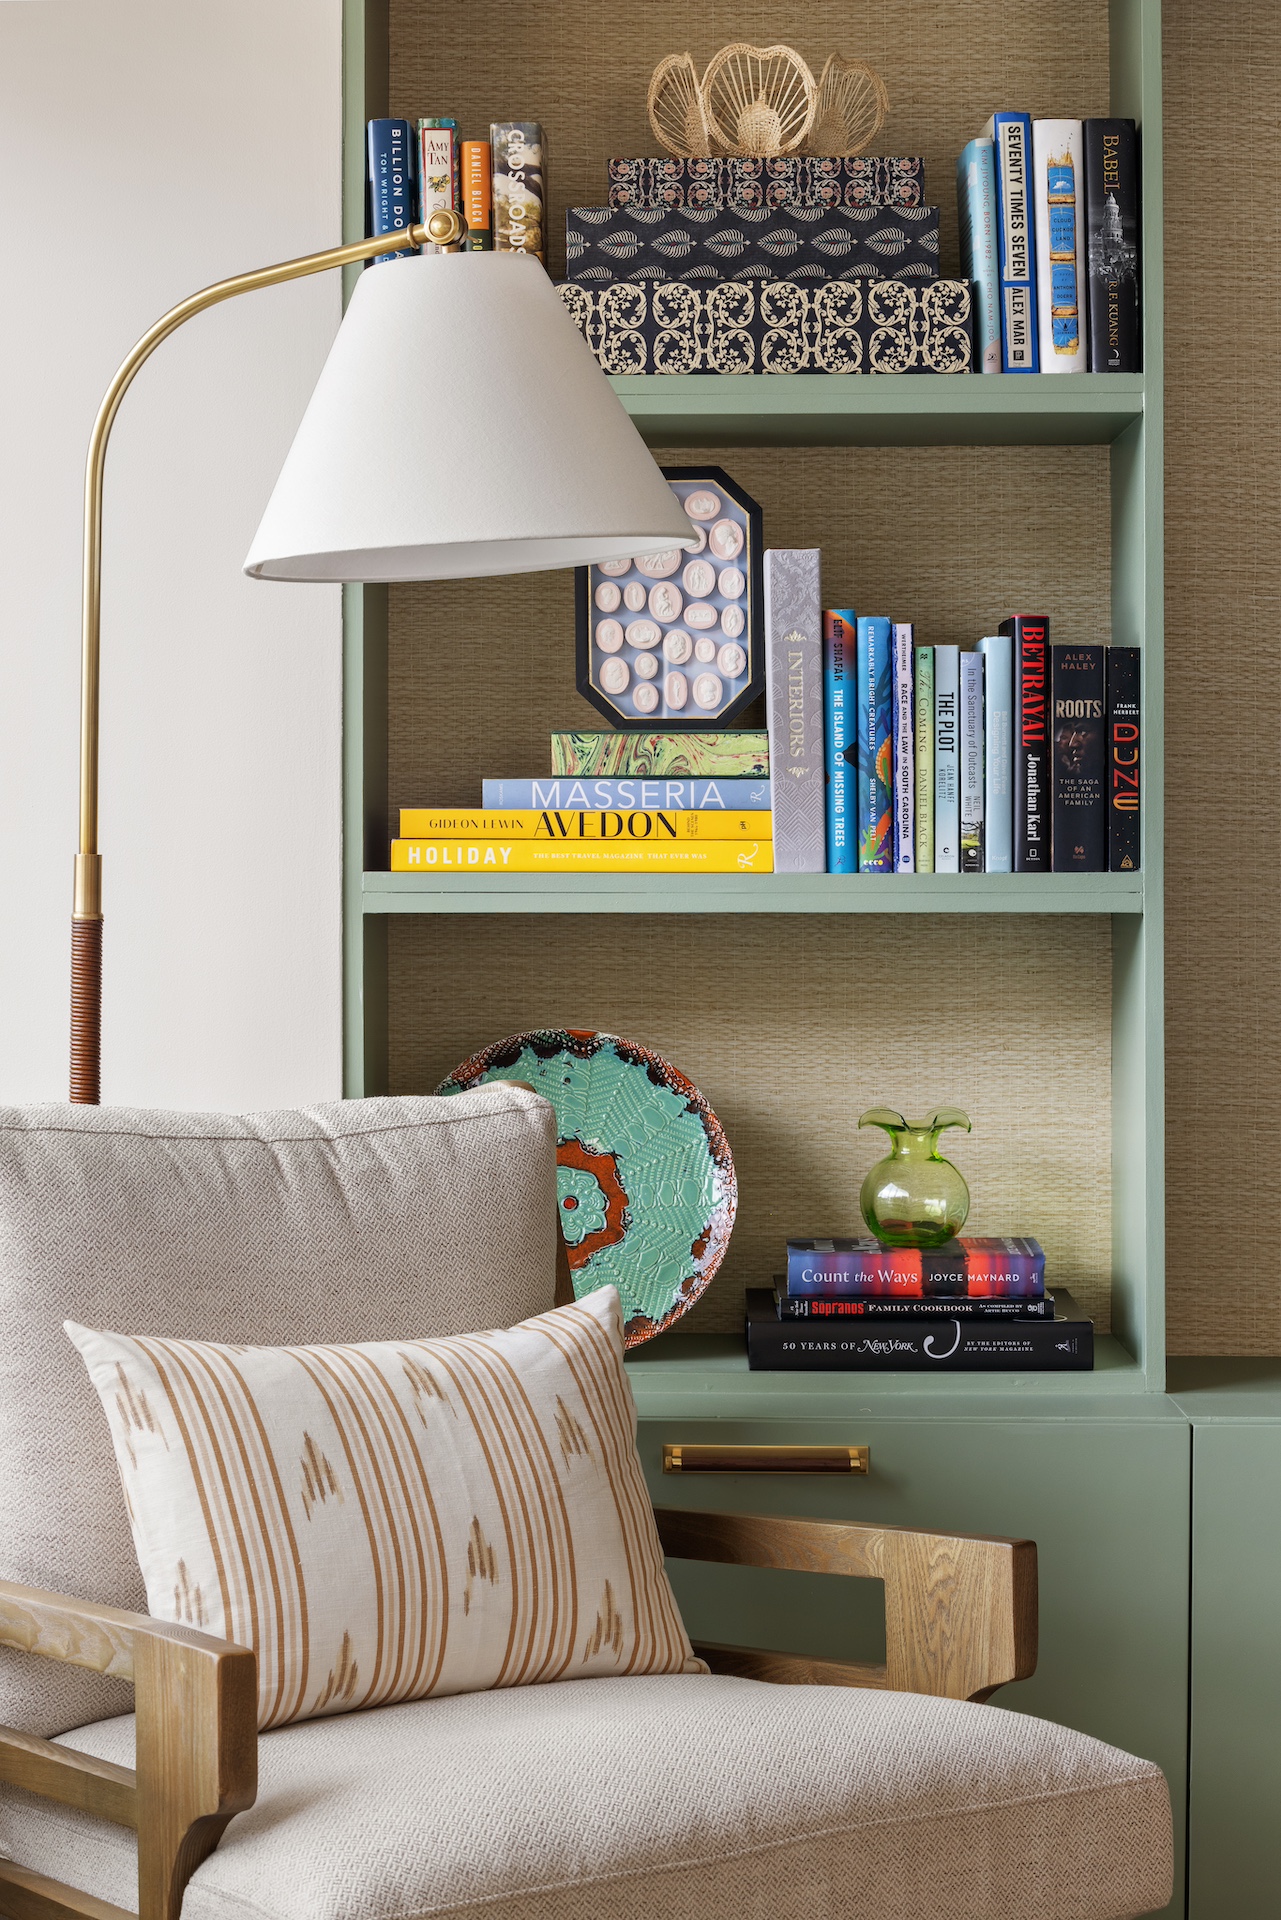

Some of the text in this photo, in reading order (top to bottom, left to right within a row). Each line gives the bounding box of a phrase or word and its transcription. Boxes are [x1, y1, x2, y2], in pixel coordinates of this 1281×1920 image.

[391, 128, 403, 196] BILLION
[427, 139, 450, 152] AMY
[427, 152, 448, 165] TAN
[1103, 134, 1121, 195] BABEL
[471, 147, 483, 223] DANIEL BLACK
[507, 129, 527, 254] CROSSROADS
[980, 168, 990, 209] JIYOUNG,
[1008, 125, 1026, 278] SEVENTY TIMES SEVEN
[983, 211, 991, 236] BORN
[1012, 287, 1024, 316] ALEX
[1108, 280, 1119, 347] R. F. KUANG
[987, 303, 995, 341] NAM-JOO
[1013, 320, 1025, 345] MAR
[833, 619, 844, 682] ELIF SHAFAK
[787, 650, 805, 757] INTERIORS
[868, 625, 876, 751] REMARKABLY BRIGHT CREATURES
[1021, 625, 1045, 747] BETRAYAL
[918, 697, 929, 753] COMING
[938, 692, 954, 753] THE PLOT
[1055, 699, 1102, 719] ROOTS
[966, 668, 978, 789] In the Sanctuary of Outcasts
[833, 689, 845, 847] THE ISLAND OF MISSING TREES
[991, 711, 1001, 795] Designing Your Life
[531, 781, 726, 809] MASSERIA
[869, 778, 877, 804] SHELBY
[919, 769, 927, 810] DANIEL
[938, 768, 946, 799] KORELITZ
[947, 764, 955, 803] JEAN HANFF
[1027, 753, 1041, 841] Jonathan Karl
[964, 796, 972, 817] WHITE
[973, 796, 981, 811] NEIL
[429, 818, 524, 829] GIDEON LEWIN
[533, 811, 677, 838] AVEDON
[919, 811, 928, 848] BLACK
[407, 846, 512, 865] HOLIDAY
[801, 1268, 918, 1287] Count the Ways
[928, 1273, 963, 1282] JOYCE
[967, 1273, 1020, 1282] MAYNARD
[811, 1301, 973, 1316] Sopranos FAMILY COOKBOOK
[782, 1342, 796, 1350] 50
[800, 1342, 837, 1350] YEARS
[840, 1342, 856, 1350] OF
